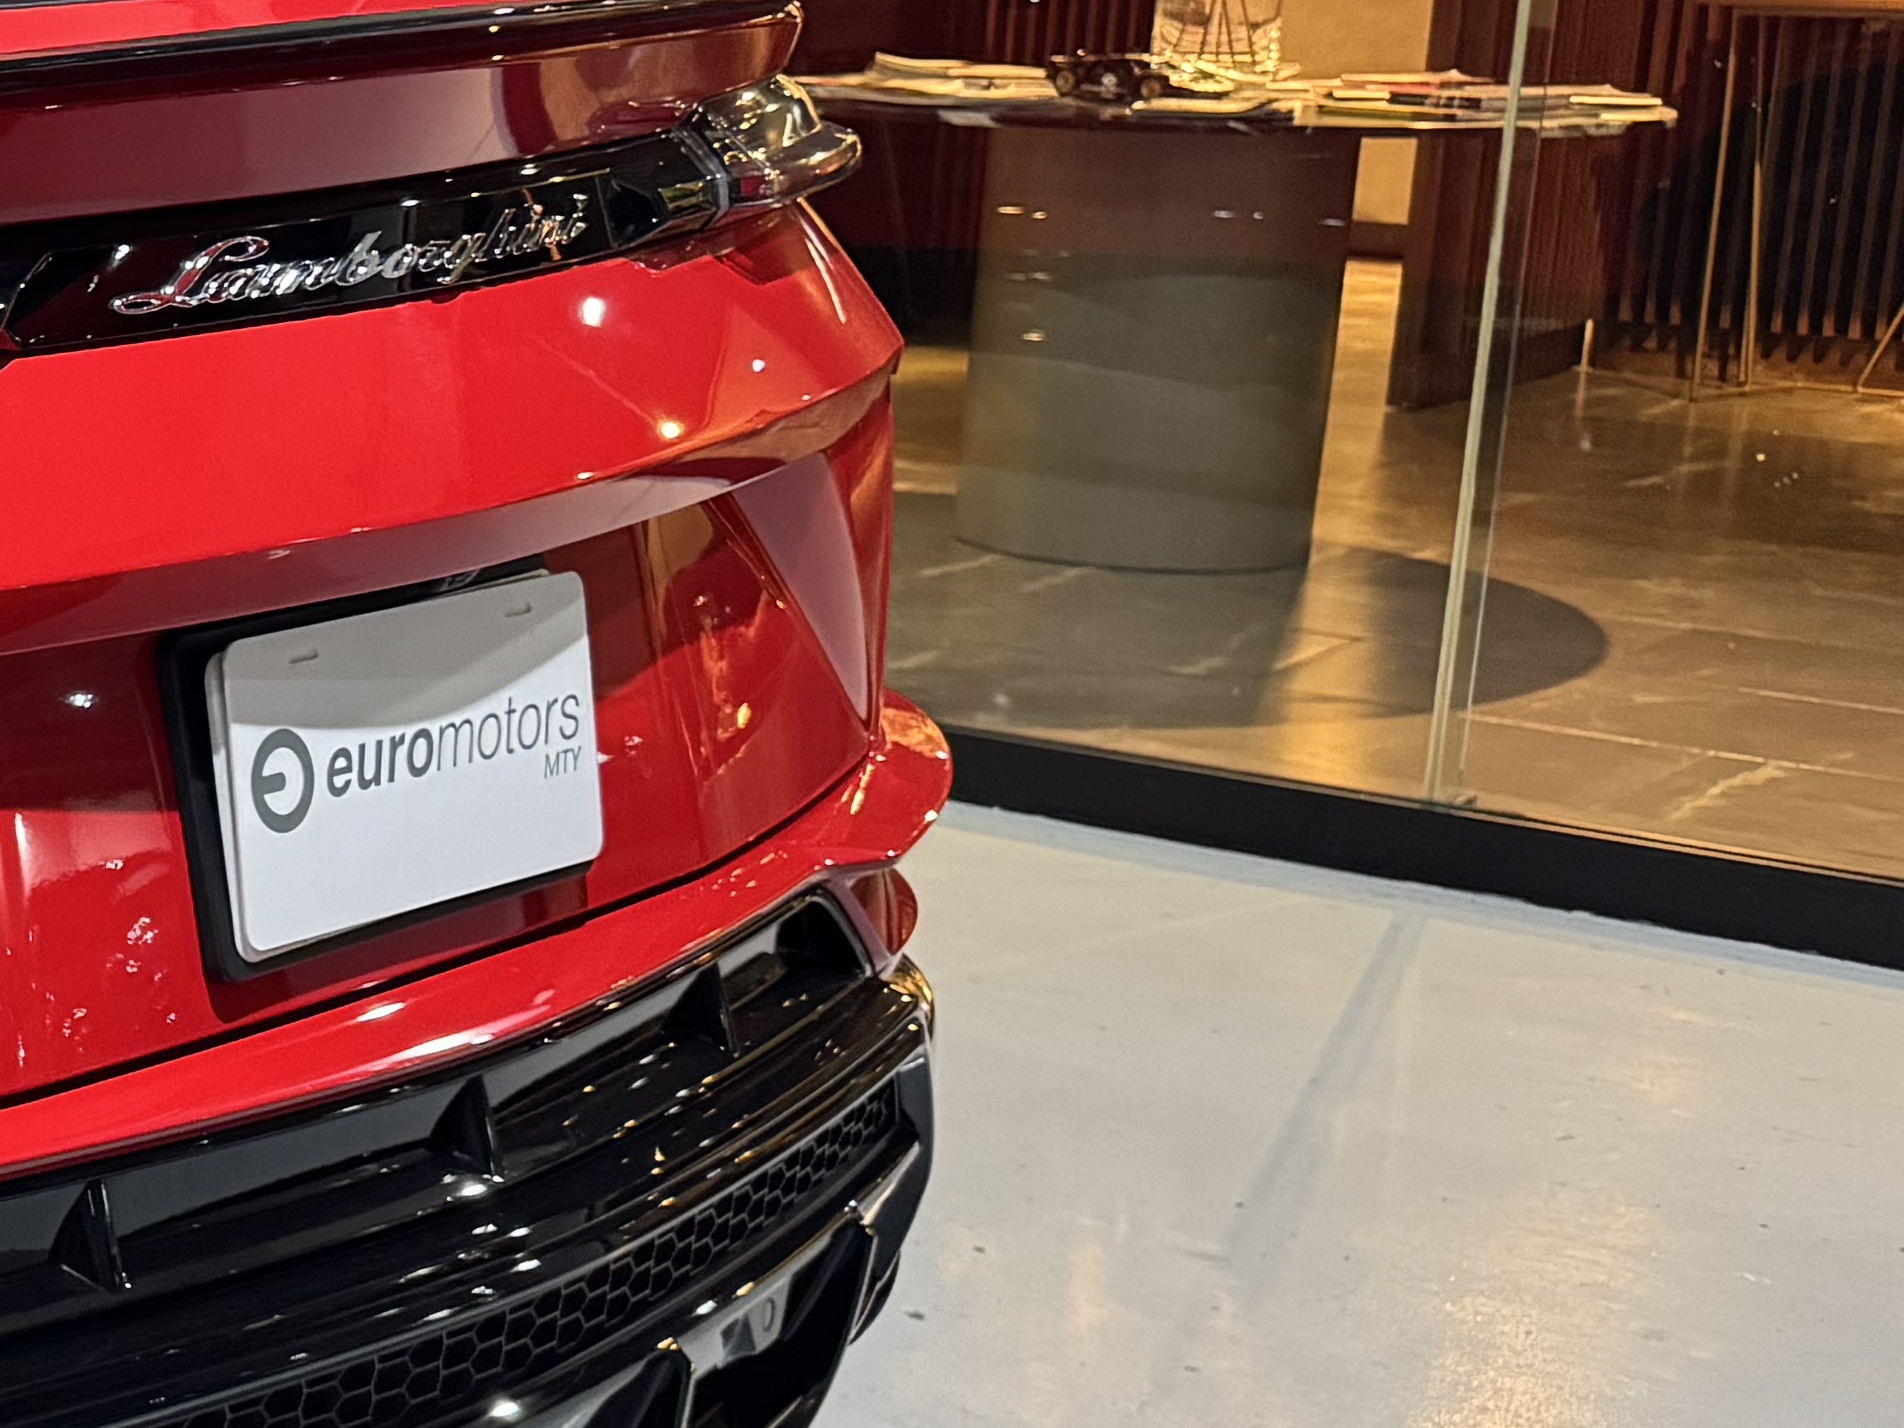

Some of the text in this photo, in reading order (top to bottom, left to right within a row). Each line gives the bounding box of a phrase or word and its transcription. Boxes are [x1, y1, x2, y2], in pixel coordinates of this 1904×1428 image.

[109, 192, 589, 315] Lamborghini
[326, 692, 582, 798] euromotors
[543, 746, 583, 780] MTY
